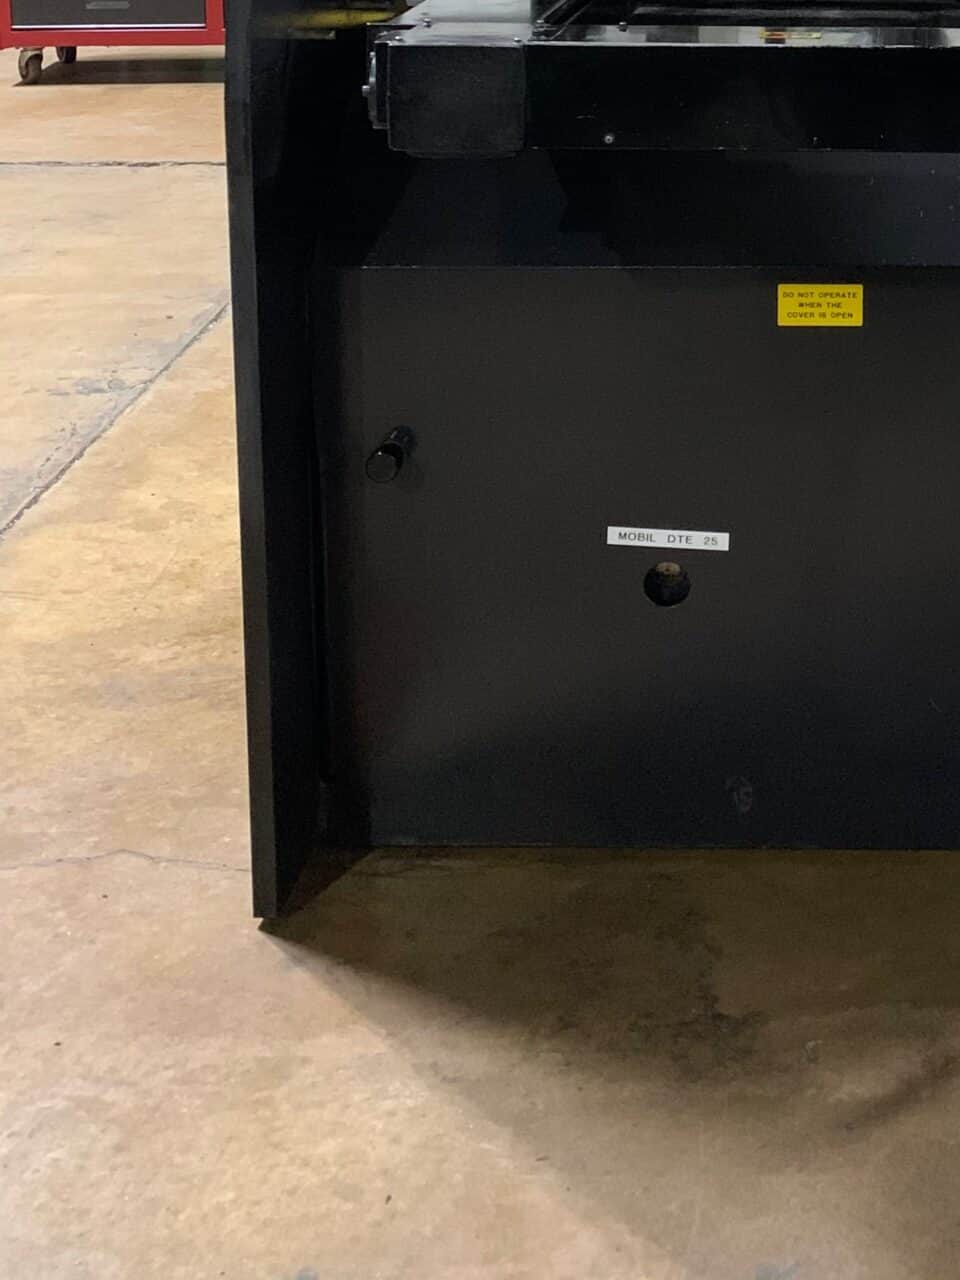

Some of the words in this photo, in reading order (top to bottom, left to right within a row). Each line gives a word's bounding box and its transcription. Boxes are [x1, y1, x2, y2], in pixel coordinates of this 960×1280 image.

[787, 311, 815, 319] COVER
[818, 311, 827, 319] IS
[617, 531, 656, 543] MOBIL
[667, 534, 693, 545] DTE
[703, 536, 719, 546] 25
